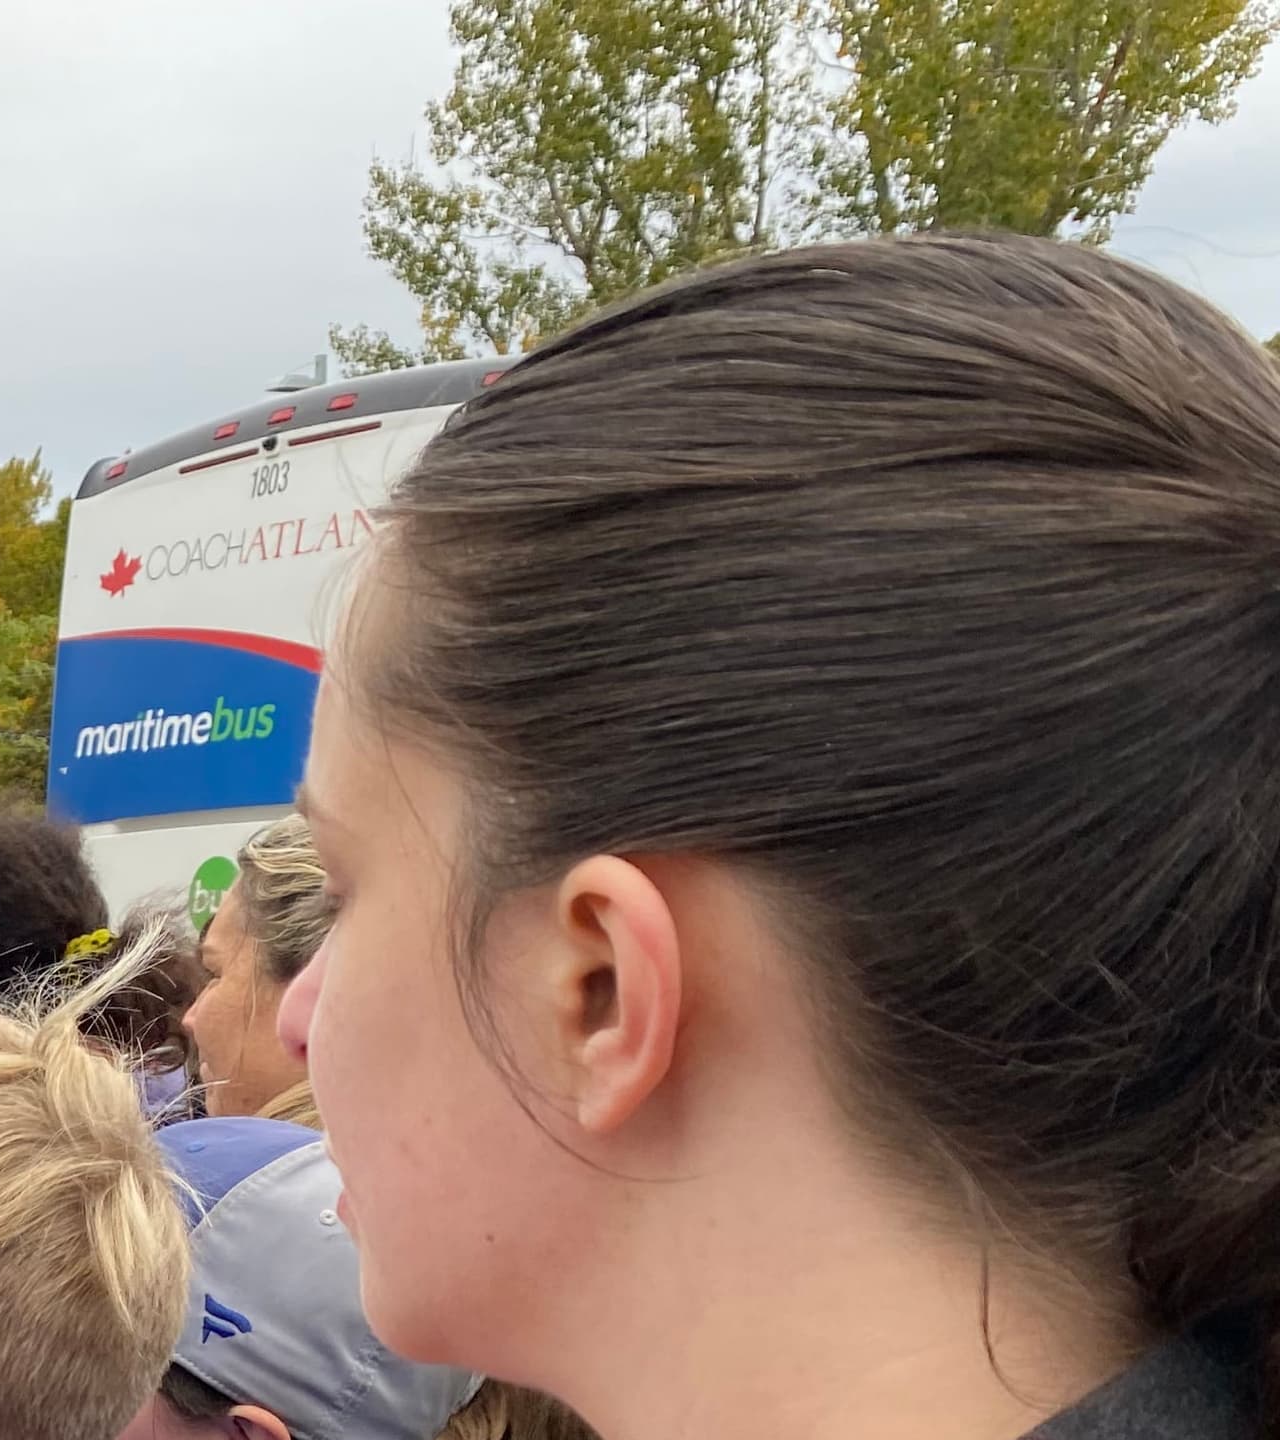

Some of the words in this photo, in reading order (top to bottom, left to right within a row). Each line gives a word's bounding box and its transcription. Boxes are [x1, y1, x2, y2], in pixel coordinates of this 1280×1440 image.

[251, 461, 290, 499] 1803
[146, 508, 377, 580] COACHATLAN
[75, 696, 276, 758] maritimebus
